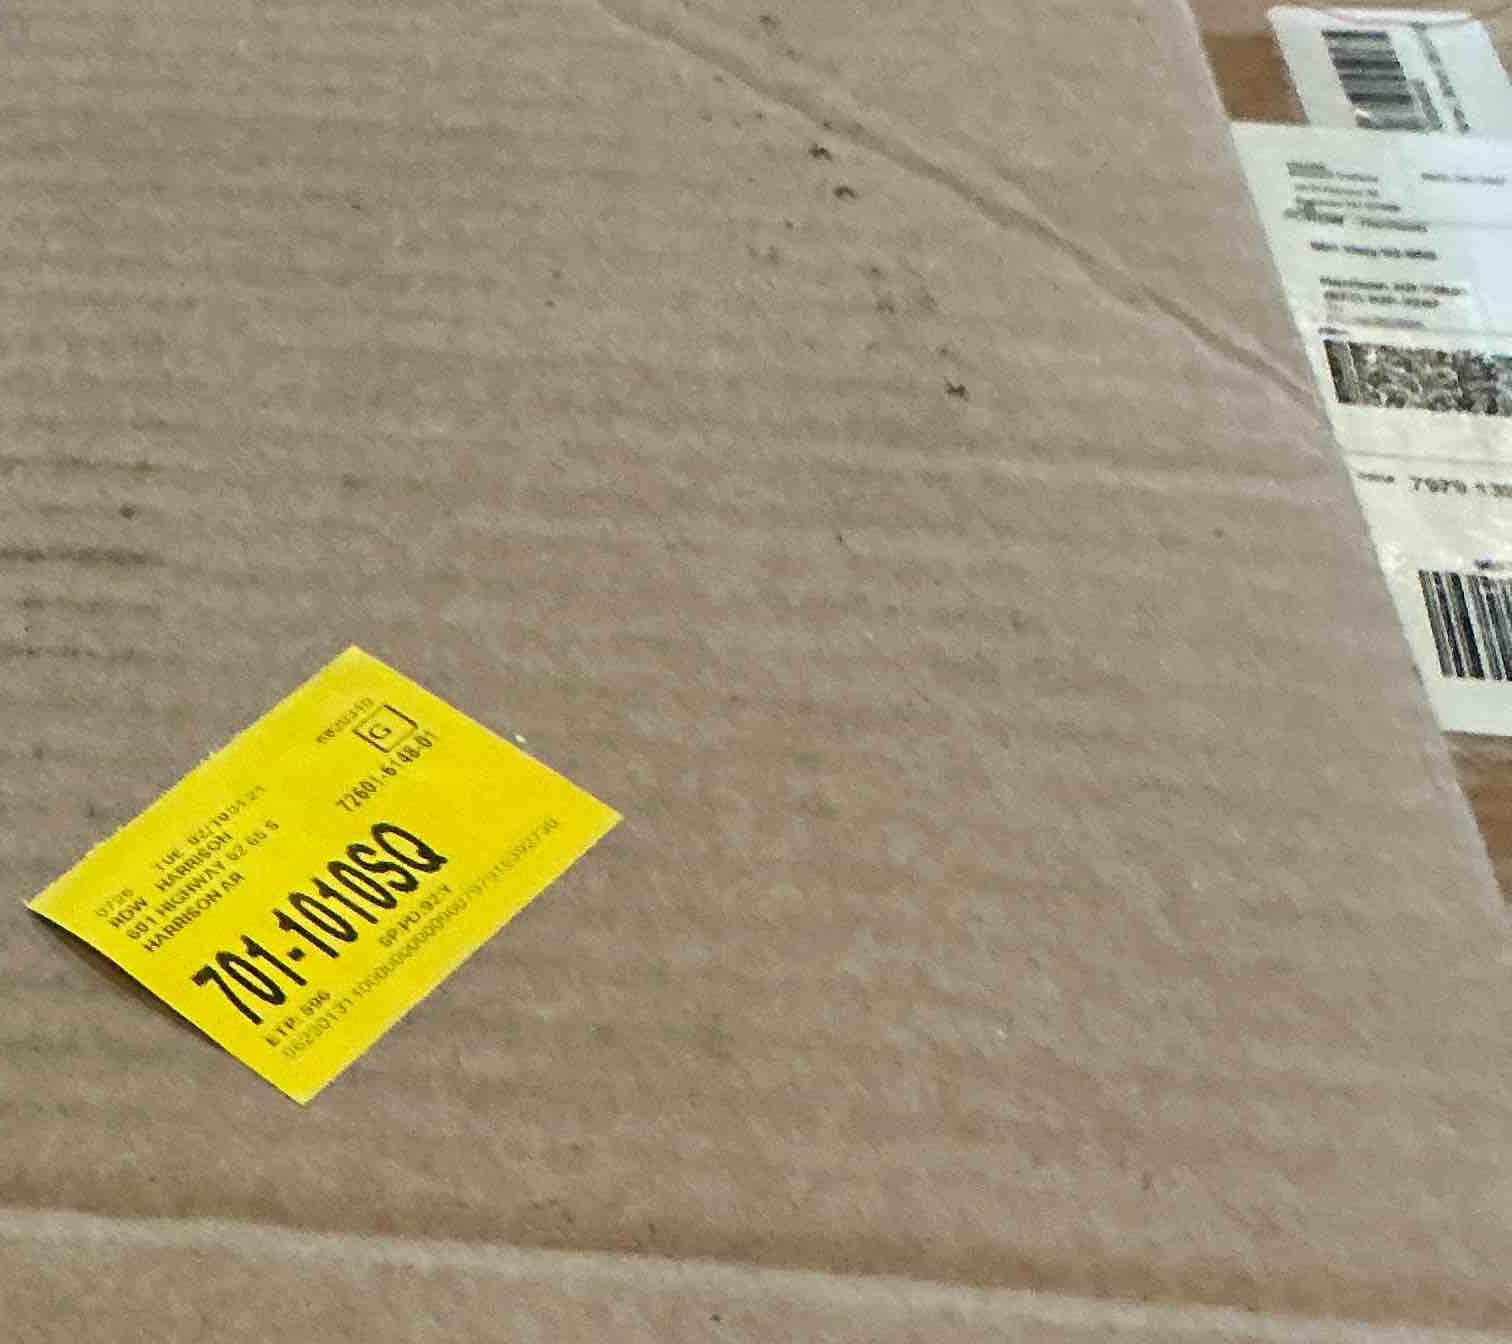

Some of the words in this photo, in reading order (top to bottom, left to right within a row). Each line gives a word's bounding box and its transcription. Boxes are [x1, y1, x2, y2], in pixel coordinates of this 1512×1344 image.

[367, 723, 391, 740] G
[154, 830, 232, 891] HARRISON
[155, 860, 226, 916] HIGHWAY
[143, 890, 221, 952] HARRISON
[195, 821, 448, 1025] 701-1010SQ
